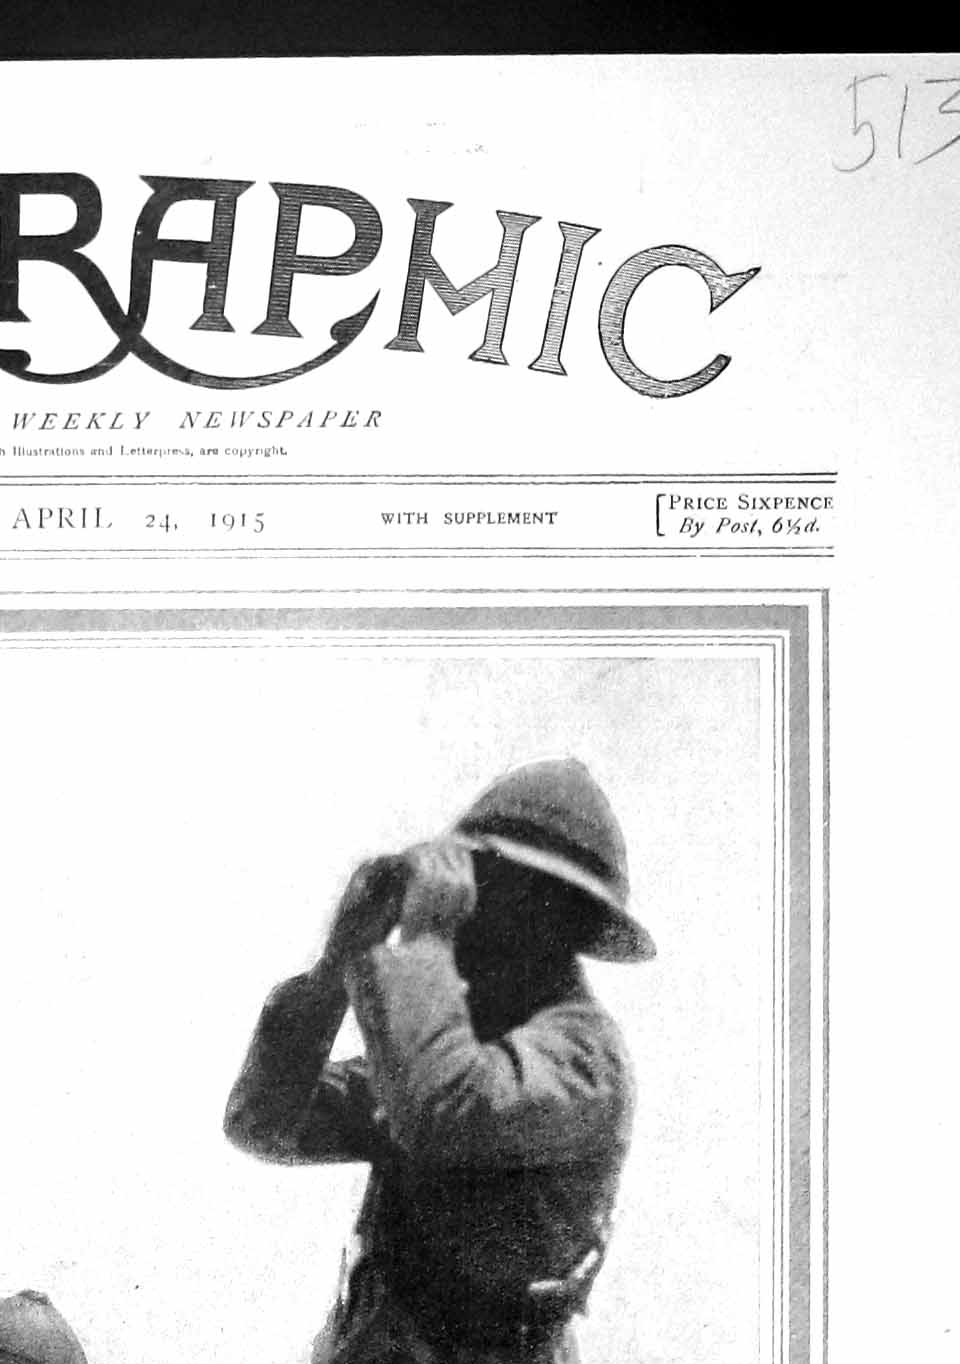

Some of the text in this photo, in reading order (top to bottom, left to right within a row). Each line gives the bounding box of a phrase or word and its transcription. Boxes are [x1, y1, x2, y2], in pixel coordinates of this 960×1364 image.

[12, 411, 152, 431] WEEKLY
[178, 409, 384, 430] NEWSPAPER
[13, 446, 85, 457] Illustrations
[90, 446, 113, 456] and
[120, 446, 194, 459] Letterpress,
[199, 447, 219, 456] are
[224, 446, 288, 459] copyright.
[12, 507, 113, 530] APRIL
[144, 513, 180, 535] 24,
[210, 512, 266, 533] 1915
[381, 510, 558, 526] WITH SUPPLEMENT
[679, 516, 705, 538] By
[716, 516, 763, 537] Post,
